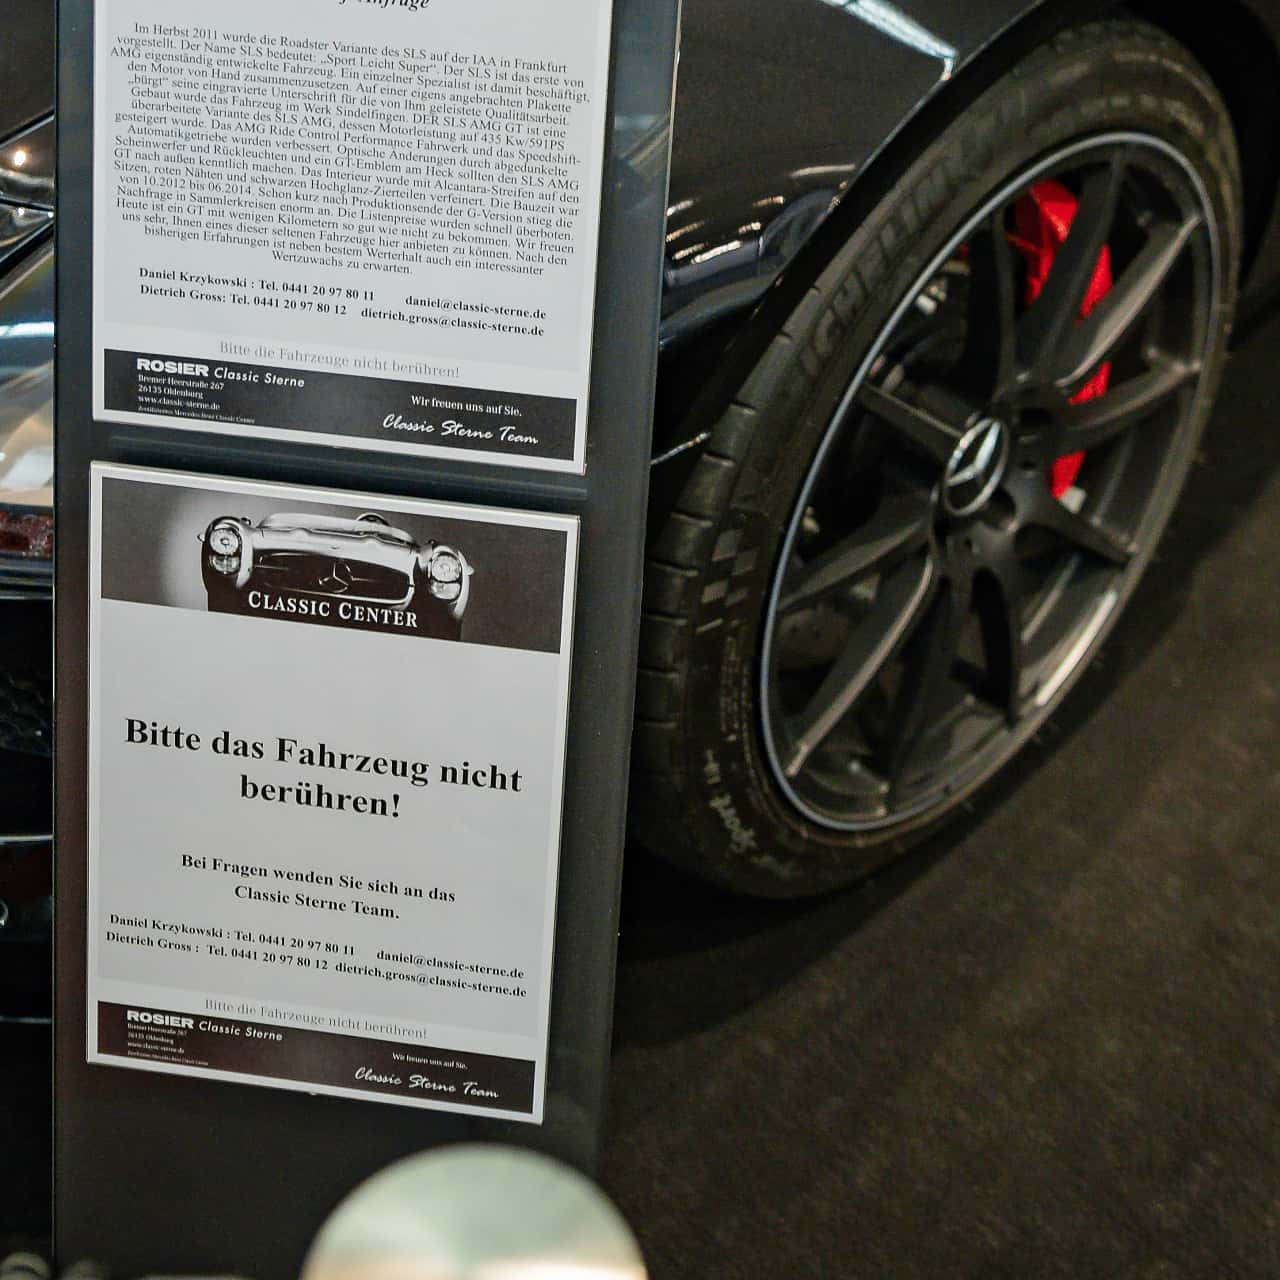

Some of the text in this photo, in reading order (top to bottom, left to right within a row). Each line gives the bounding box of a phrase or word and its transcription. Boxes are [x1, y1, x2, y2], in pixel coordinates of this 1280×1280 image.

[139, 267, 176, 281] Daniel
[179, 271, 248, 289] Krzykowski
[258, 279, 280, 293] Tel.
[282, 282, 308, 295] 0441
[312, 285, 326, 297] 20
[328, 287, 343, 298] 97
[345, 288, 360, 300] 80
[364, 290, 374, 302] 11
[405, 295, 547, 320] daniel@classic-sterne.de
[140, 283, 545, 337] Dietrich Gross: Tel. 0441 20 97 80 12 dietrich.gross@classic-sterne.de
[136, 357, 306, 389] ROSIER Classic Sterne
[219, 340, 461, 380] Bitte die Fahrzeuge nicht berühren!
[382, 412, 540, 445] Classic Sterne Team
[248, 590, 418, 629] CLASSIC CENTER
[125, 718, 523, 793] Bitte das Fahrzeug nicht
[240, 774, 401, 819] berühren!
[181, 854, 456, 903] Bei Fragen wenden Sie sich an das
[234, 885, 400, 920] Classic Sterne Team.
[106, 930, 155, 948] Dietrich
[157, 937, 192, 953] Gross
[206, 943, 229, 958] Tel.
[231, 947, 258, 962] 0441
[262, 951, 277, 964] 20
[279, 954, 294, 967] 97
[296, 956, 312, 968] 80
[315, 959, 329, 971] 12
[335, 962, 528, 998] dietrich.gross@classic-sterne.de
[110, 913, 149, 930] Daniel
[151, 919, 224, 939] Krzykowski
[233, 930, 256, 944] Tel.
[258, 933, 286, 947] 0441
[290, 937, 305, 949] 20
[307, 940, 322, 952] 97
[324, 943, 340, 954] 80
[344, 944, 355, 957] 11
[376, 950, 525, 980] daniel@classic-sterne.de
[126, 1009, 195, 1030] ROSIER
[198, 1020, 242, 1037] Classic
[245, 1026, 284, 1042] Sterne
[205, 999, 427, 1041] Bitte die Fahrzeuge nicht berühren!
[354, 1065, 500, 1099] Classic Sterne Team
